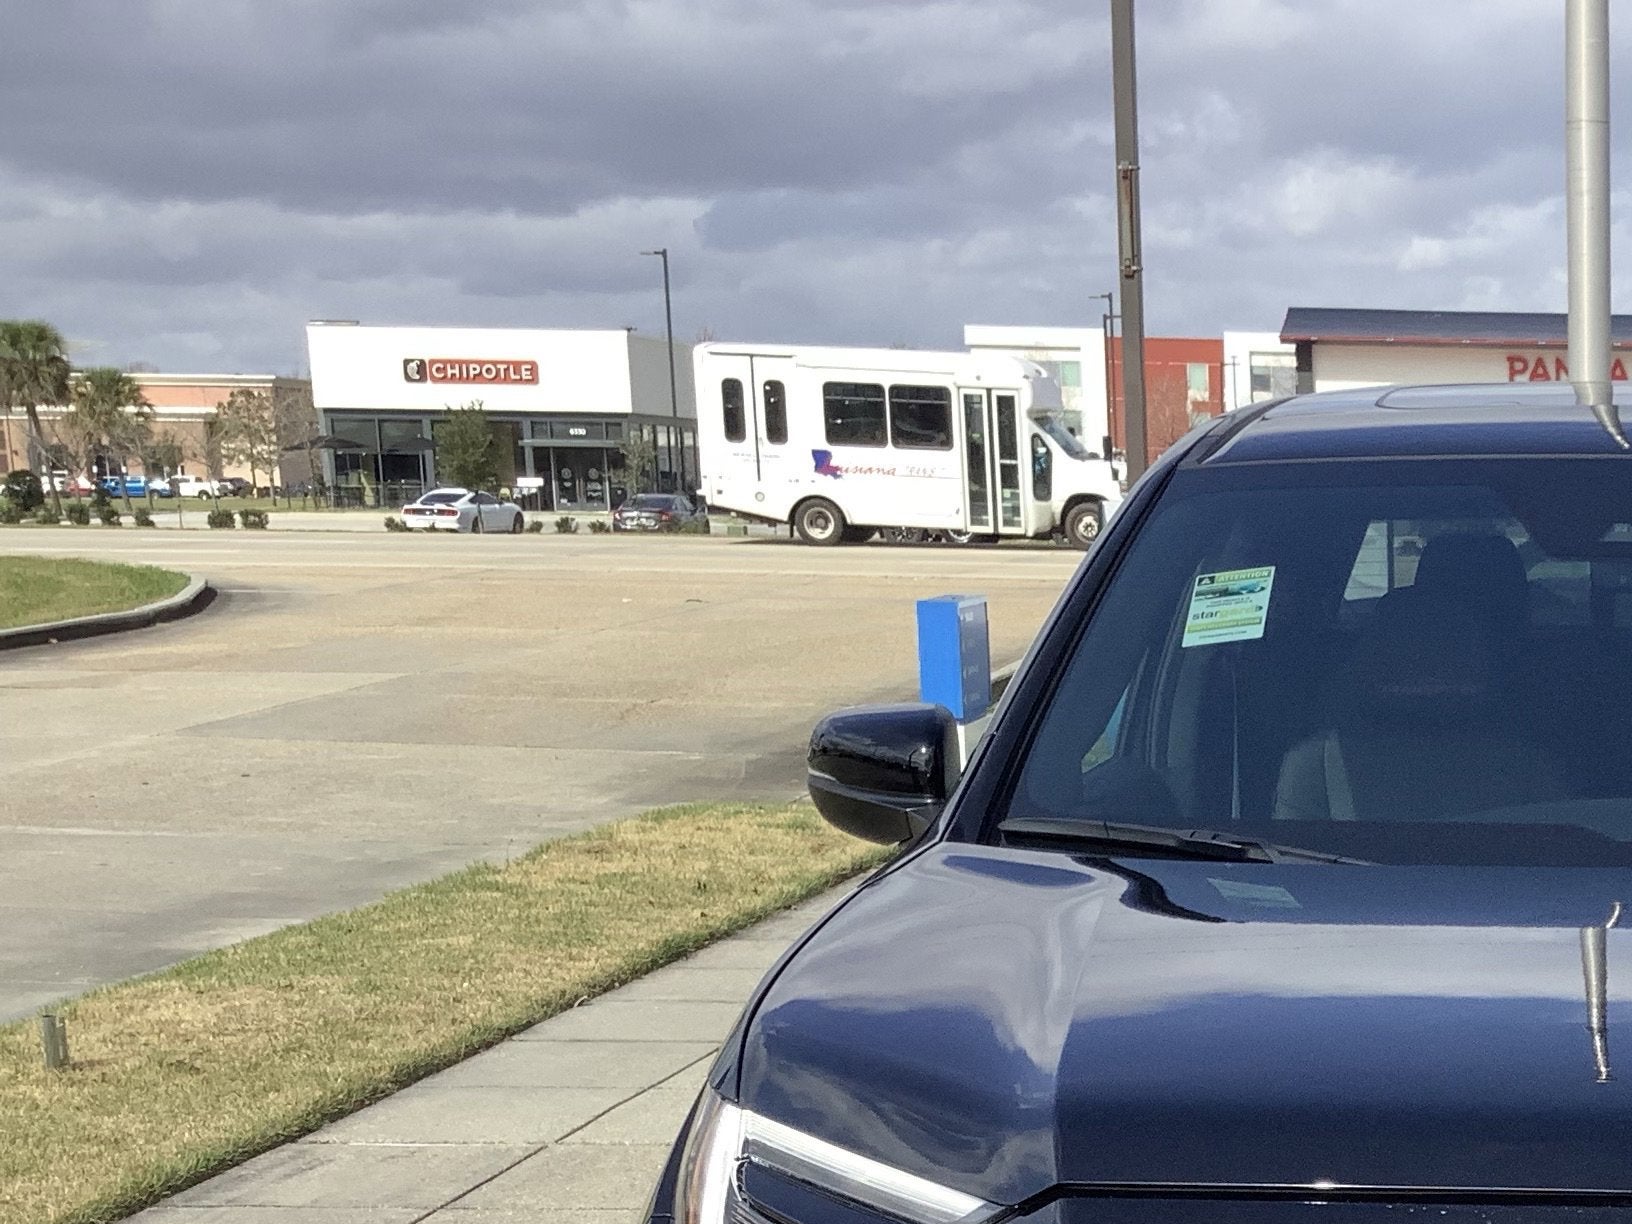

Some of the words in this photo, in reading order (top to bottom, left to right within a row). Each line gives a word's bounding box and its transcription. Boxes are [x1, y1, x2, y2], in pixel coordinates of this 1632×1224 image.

[431, 362, 534, 381] CHIPOTLE
[1506, 356, 1628, 382] PANA
[1219, 569, 1270, 583] ATTENTION
